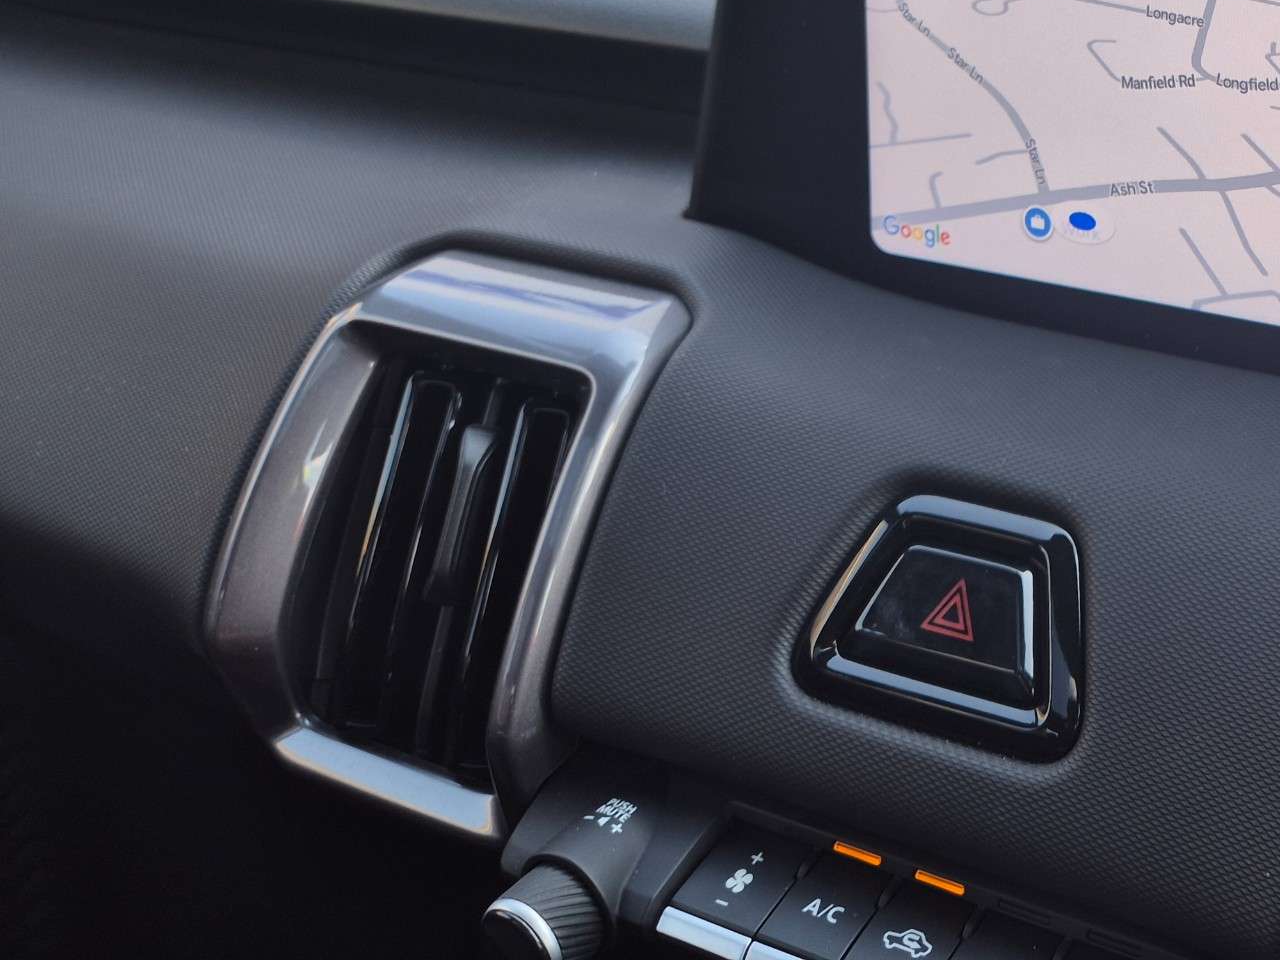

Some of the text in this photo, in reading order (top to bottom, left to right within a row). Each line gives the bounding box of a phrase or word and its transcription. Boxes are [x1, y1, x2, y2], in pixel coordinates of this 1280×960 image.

[898, 2, 931, 38] Star Ln
[1146, 4, 1205, 28] Longacre
[947, 47, 984, 85] Star Ln
[1120, 73, 1196, 90] Manfield Rd
[1216, 72, 1279, 94] Longfield
[1025, 138, 1046, 185] Star Ln
[1110, 180, 1153, 197] Ash St
[882, 214, 951, 248] Google
[595, 803, 632, 824] MUTE
[605, 797, 638, 815] PUSH
[801, 897, 846, 925] A/C
